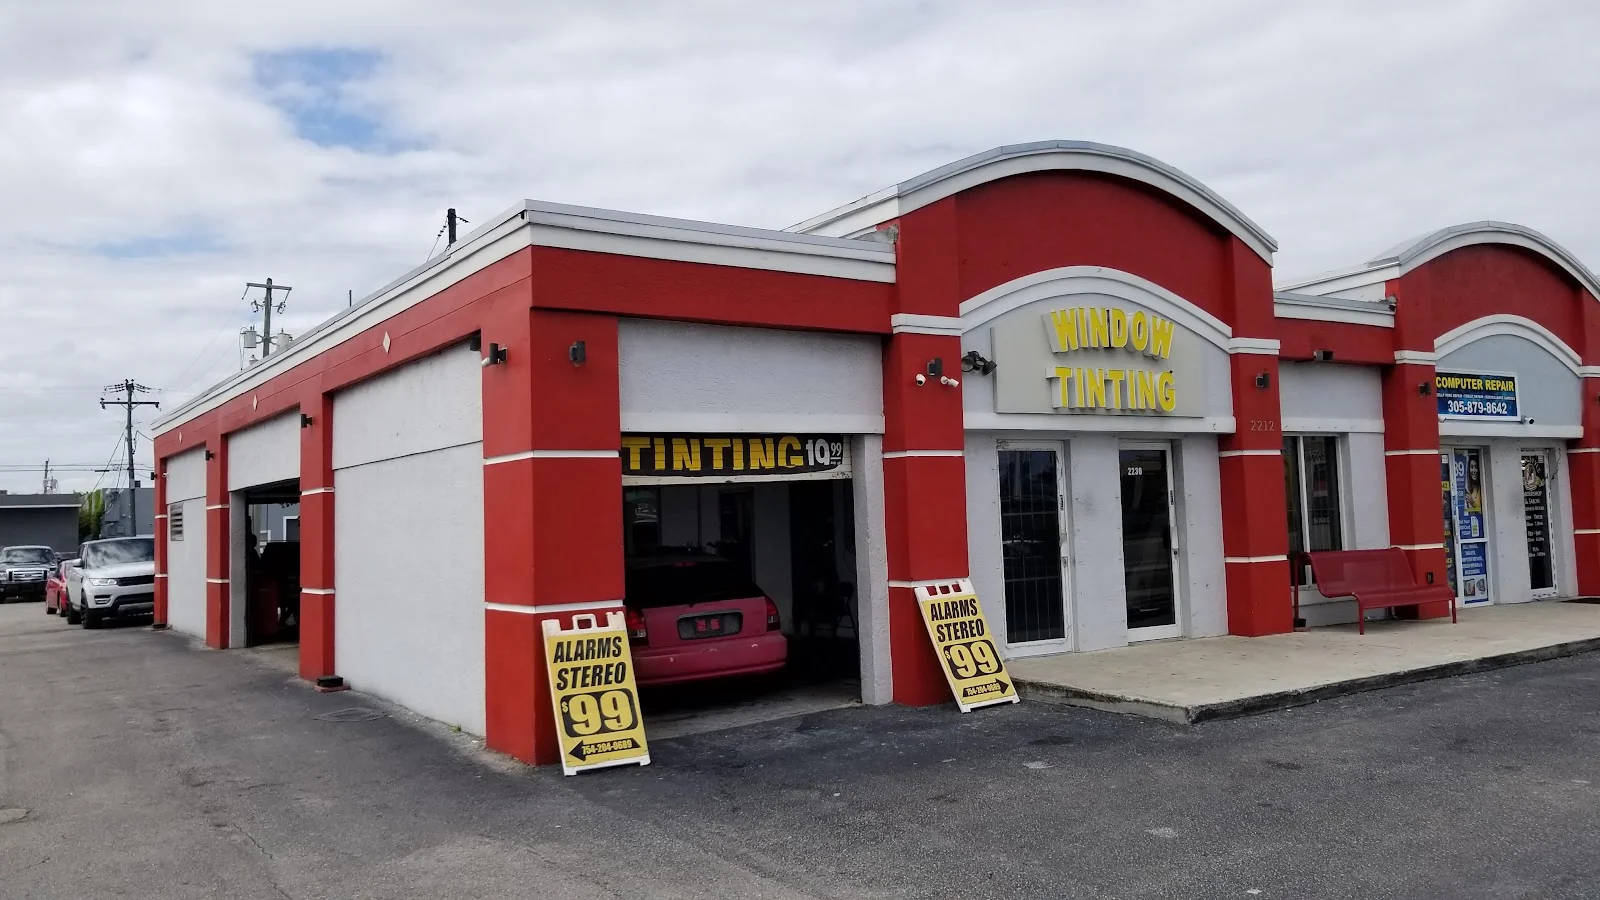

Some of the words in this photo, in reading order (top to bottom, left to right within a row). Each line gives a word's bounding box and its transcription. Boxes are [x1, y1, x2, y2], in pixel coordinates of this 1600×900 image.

[1050, 307, 1175, 359] WINDOW
[1054, 366, 1176, 412] TINTING
[1436, 377, 1483, 390] COMPUTER
[1485, 379, 1514, 391] REPAIR
[1447, 400, 1507, 414] 305-879-8642
[1250, 420, 1275, 431] 2212
[622, 435, 804, 471] TINTING
[930, 598, 978, 622] ALARMS
[936, 618, 985, 643] STEREO
[553, 636, 622, 663] ALARMS
[556, 662, 627, 691] STEREO
